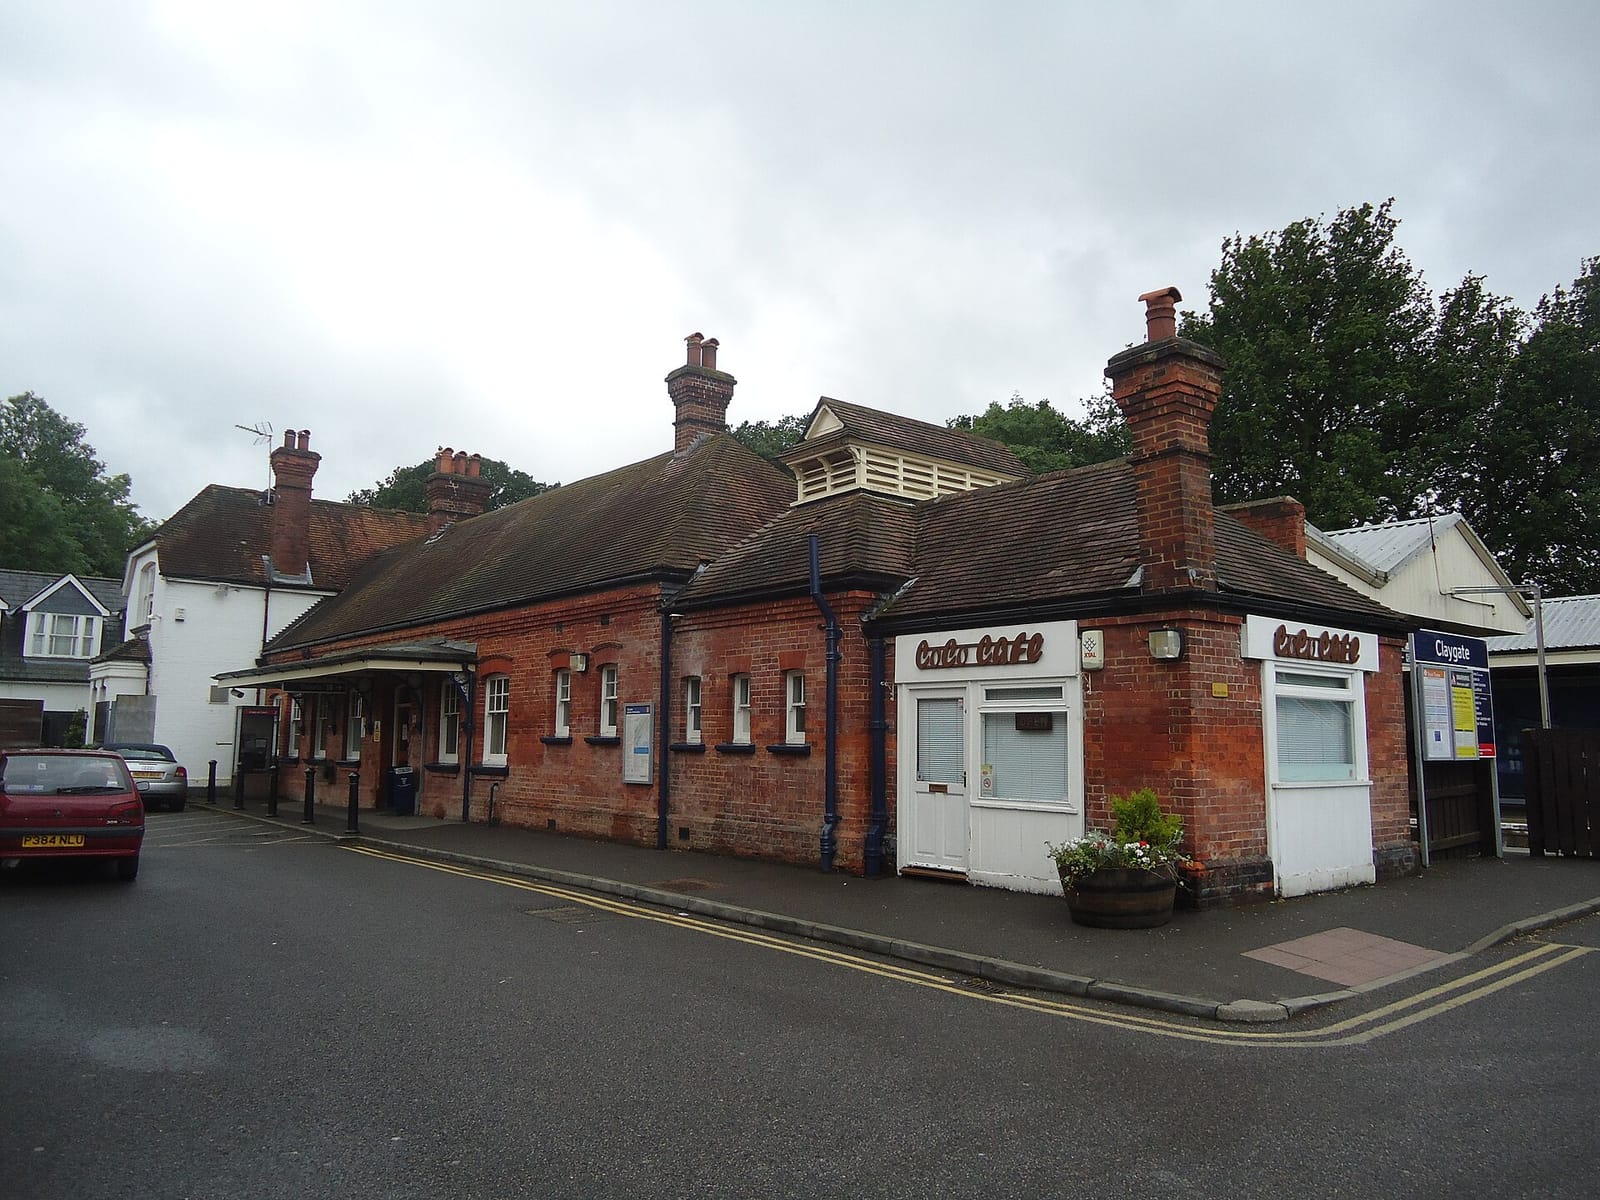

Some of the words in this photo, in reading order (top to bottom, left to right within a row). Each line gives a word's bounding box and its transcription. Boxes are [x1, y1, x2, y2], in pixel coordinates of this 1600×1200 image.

[1435, 639, 1471, 663] Claygate
[24, 835, 56, 846] P384
[59, 834, 84, 846] NLU
